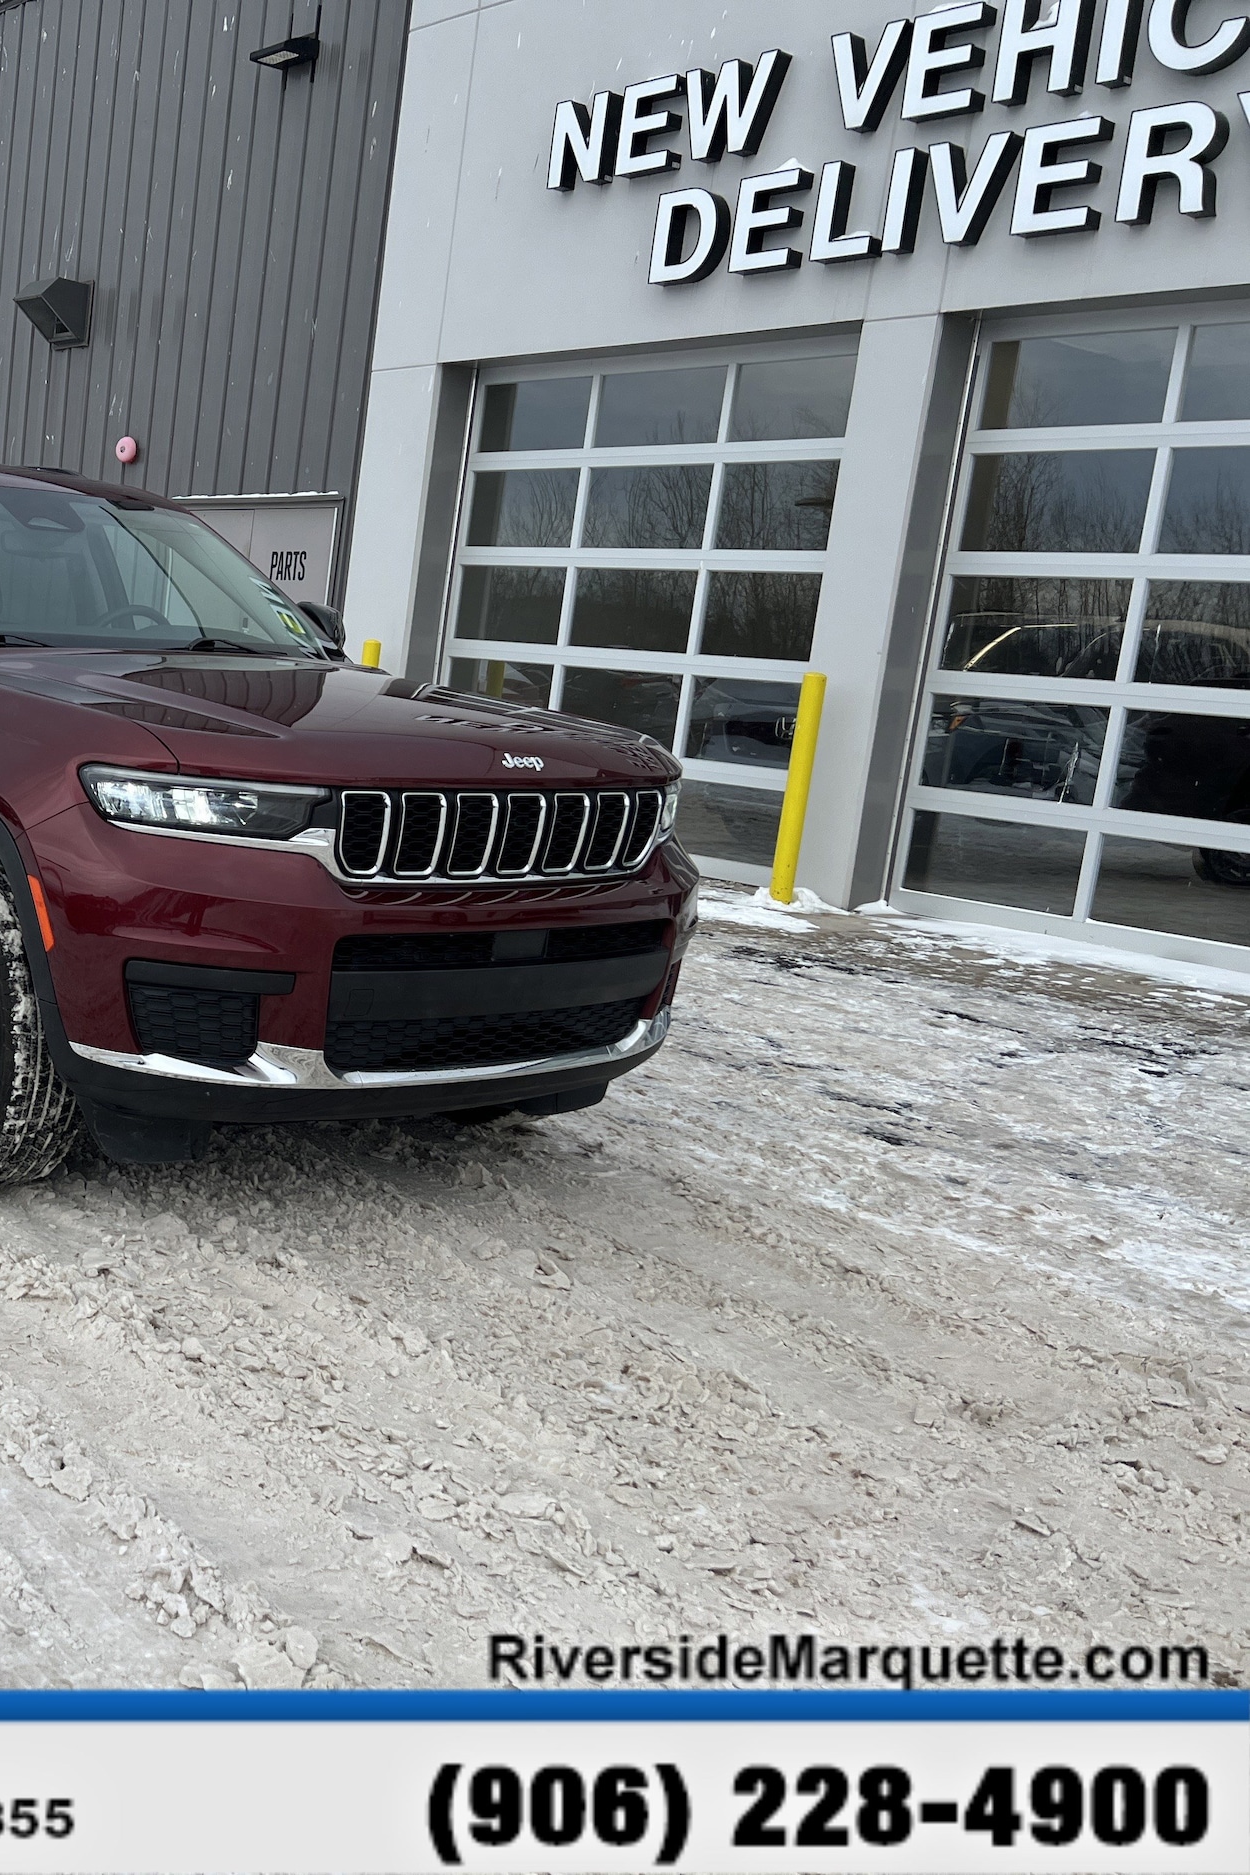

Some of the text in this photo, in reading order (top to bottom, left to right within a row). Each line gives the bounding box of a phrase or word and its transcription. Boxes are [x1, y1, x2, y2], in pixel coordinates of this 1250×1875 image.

[547, 0, 1250, 192] NEW VEHIC
[648, 91, 1250, 287] DELIVER
[269, 551, 307, 581] PARTS
[501, 752, 545, 772] Jeep
